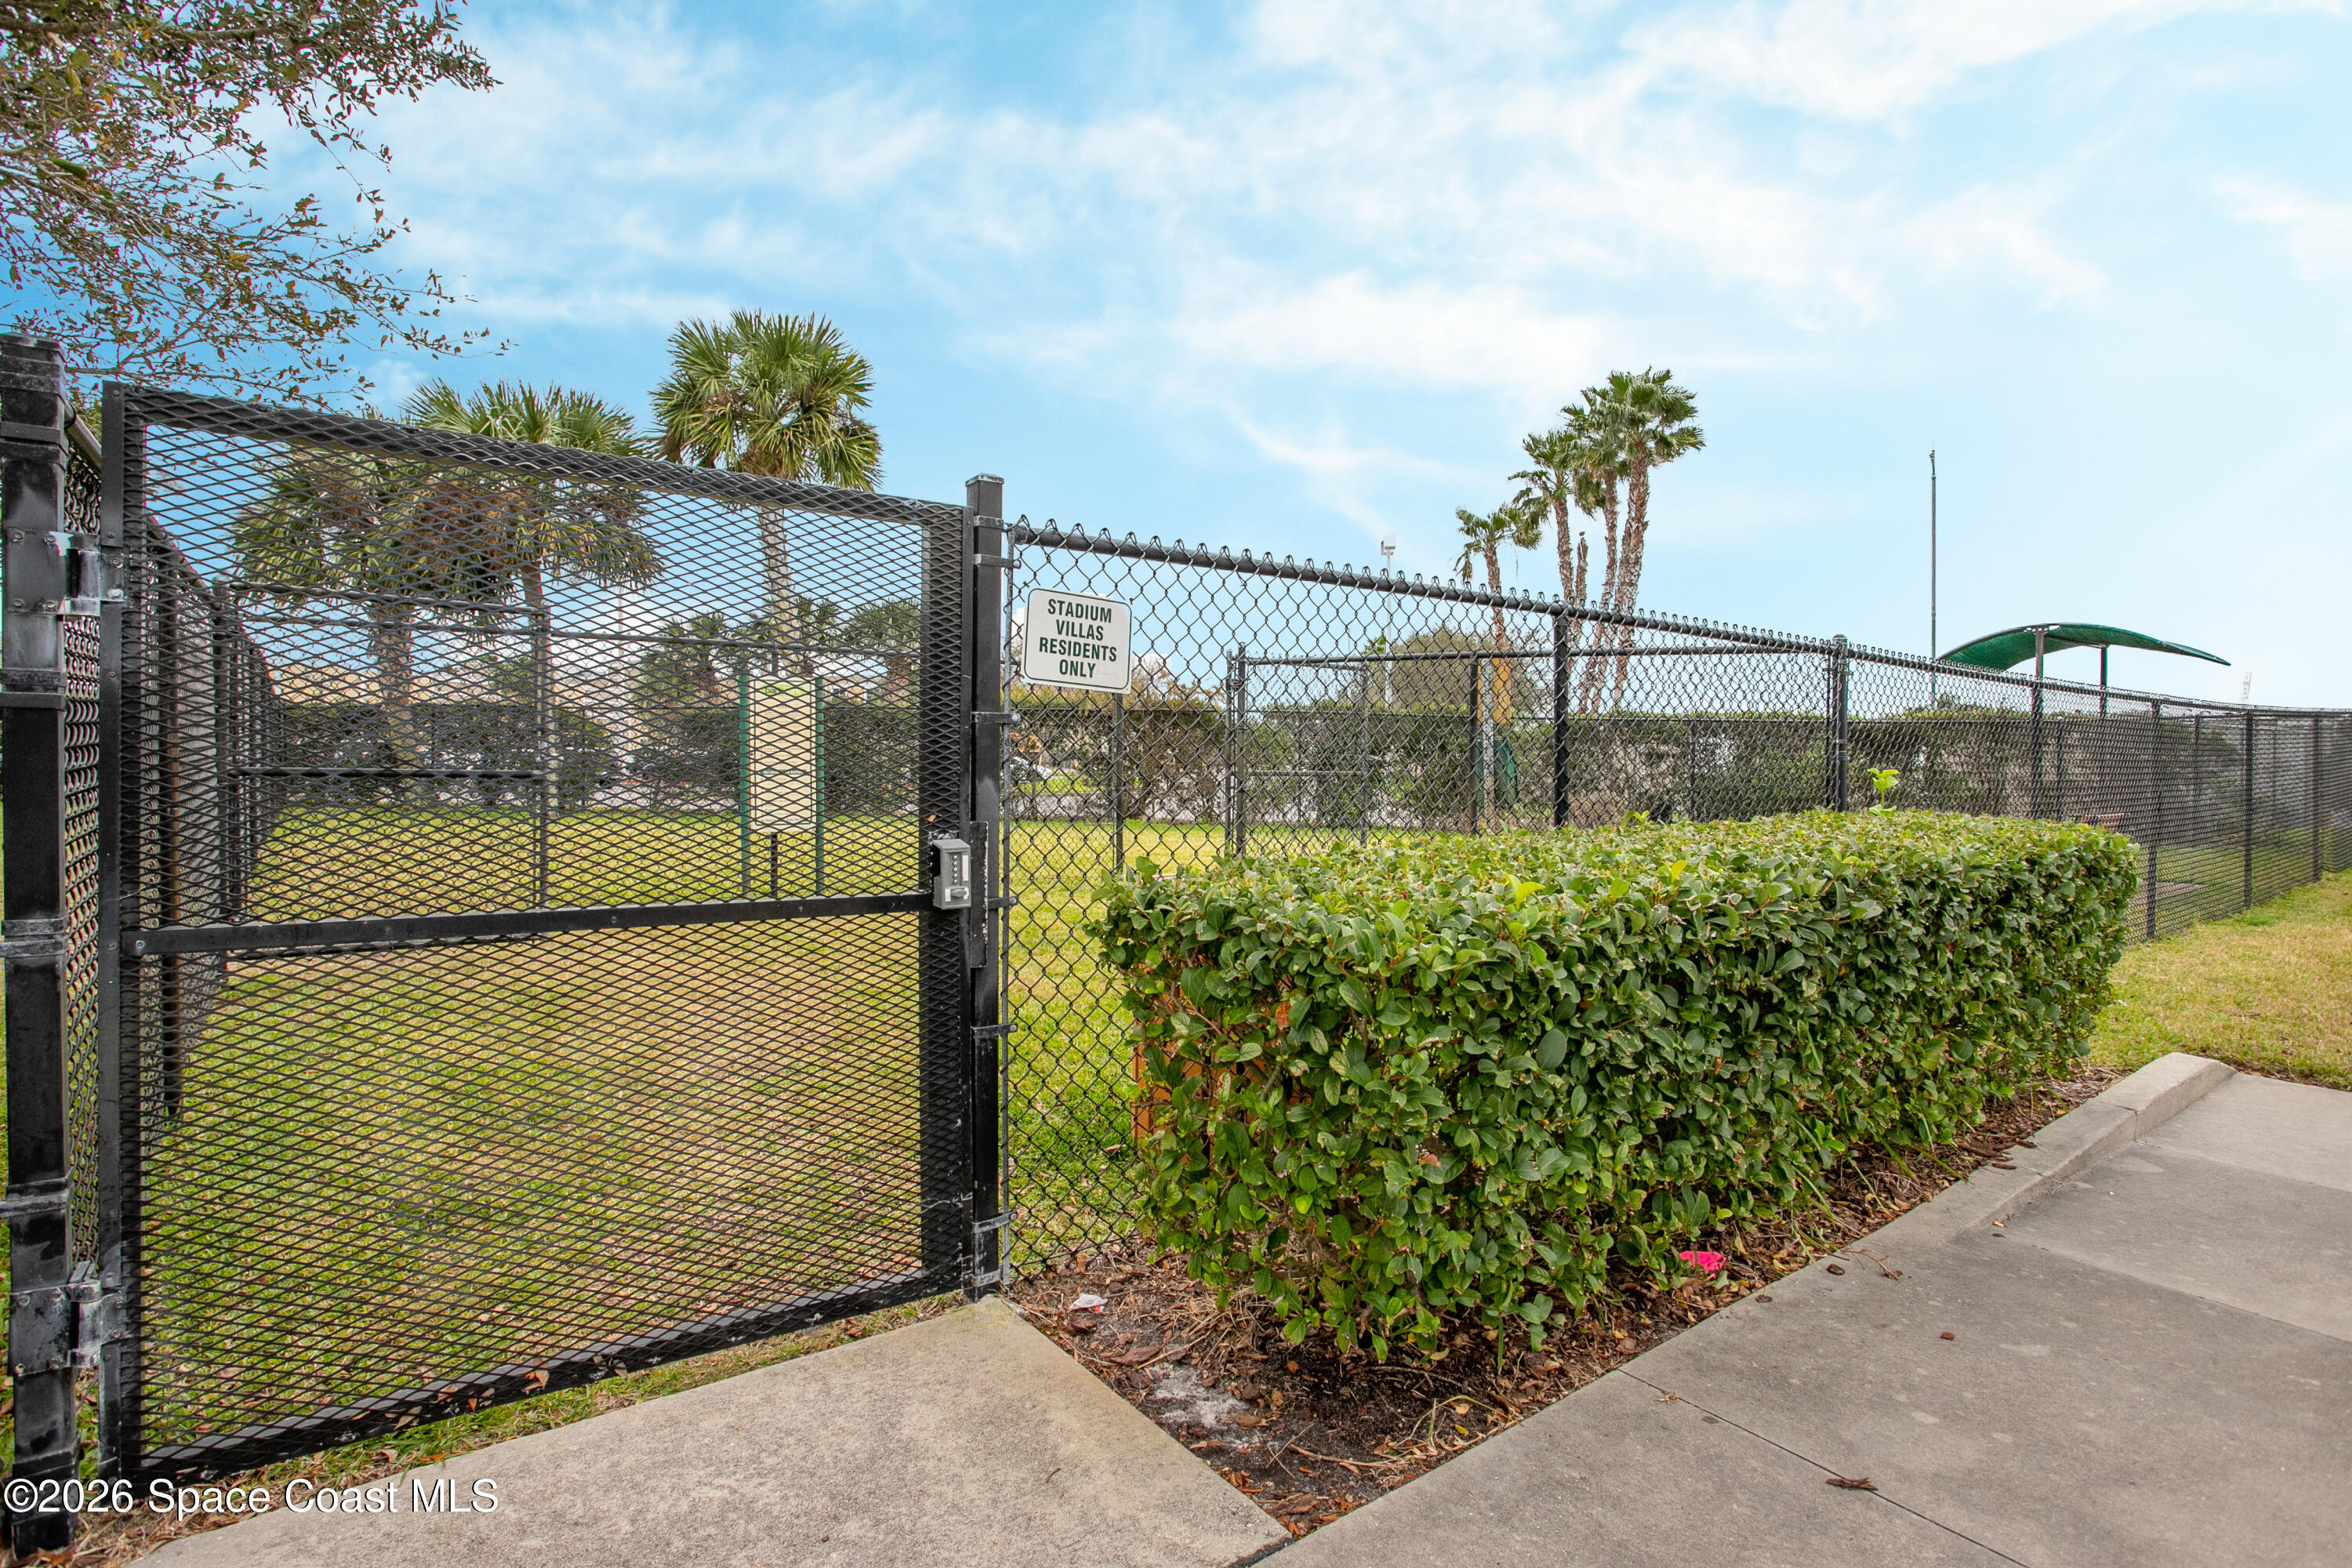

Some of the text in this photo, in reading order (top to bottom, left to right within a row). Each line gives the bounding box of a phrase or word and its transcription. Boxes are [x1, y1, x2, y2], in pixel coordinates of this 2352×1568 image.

[1047, 598, 1112, 623] STADIUM
[1056, 619, 1104, 641] VILLAS
[1039, 637, 1116, 662] RESIDENTS
[1059, 659, 1096, 678] ONLY
